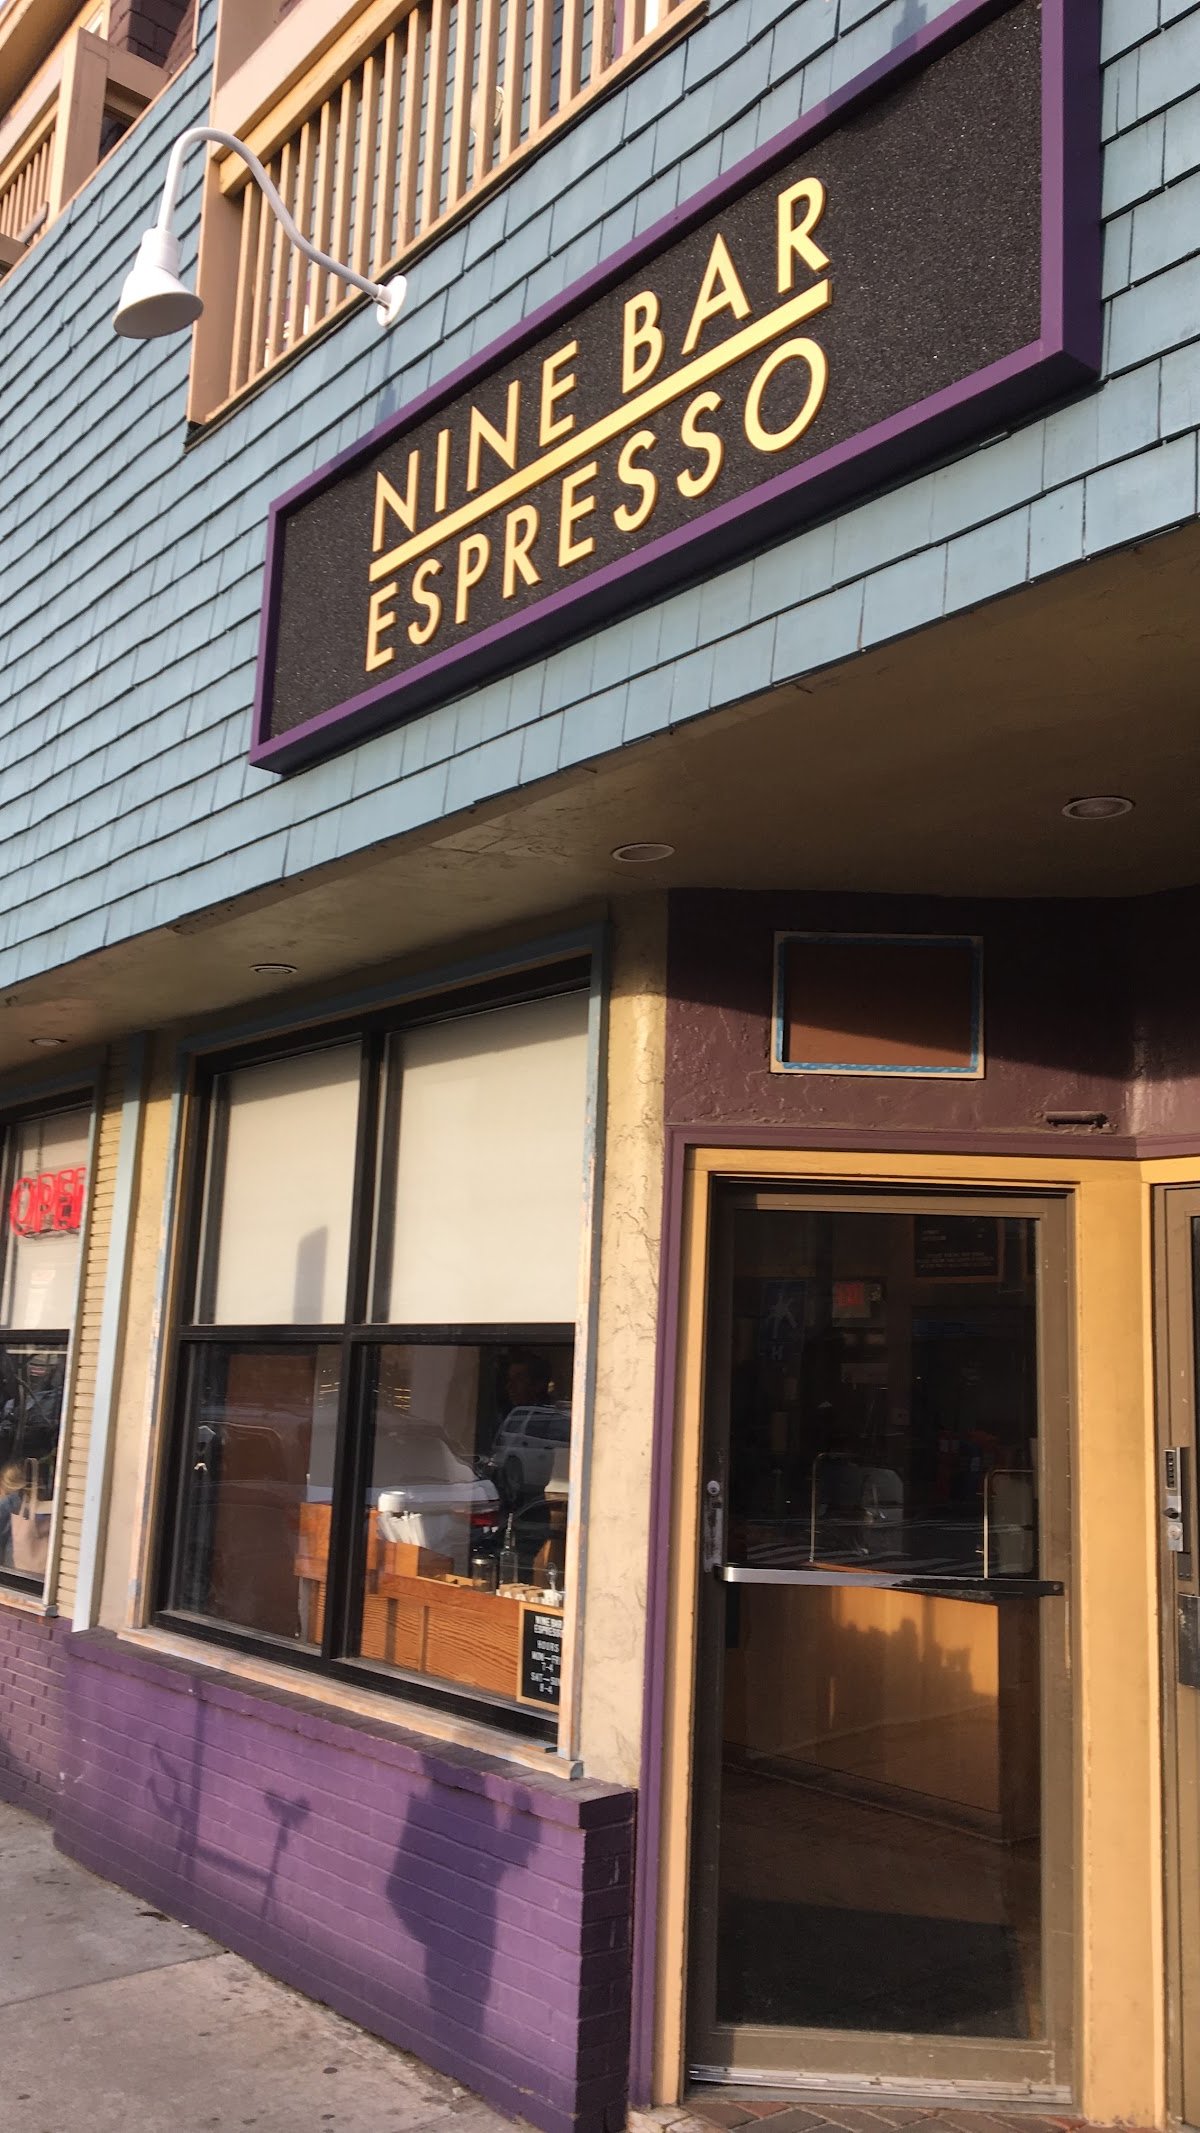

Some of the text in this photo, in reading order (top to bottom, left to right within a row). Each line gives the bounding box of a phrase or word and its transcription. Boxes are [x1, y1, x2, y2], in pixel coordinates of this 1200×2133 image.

[364, 336, 829, 673] ESPRESSO
[371, 177, 832, 553] NINE BAR
[536, 1640, 559, 1652] HOURS
